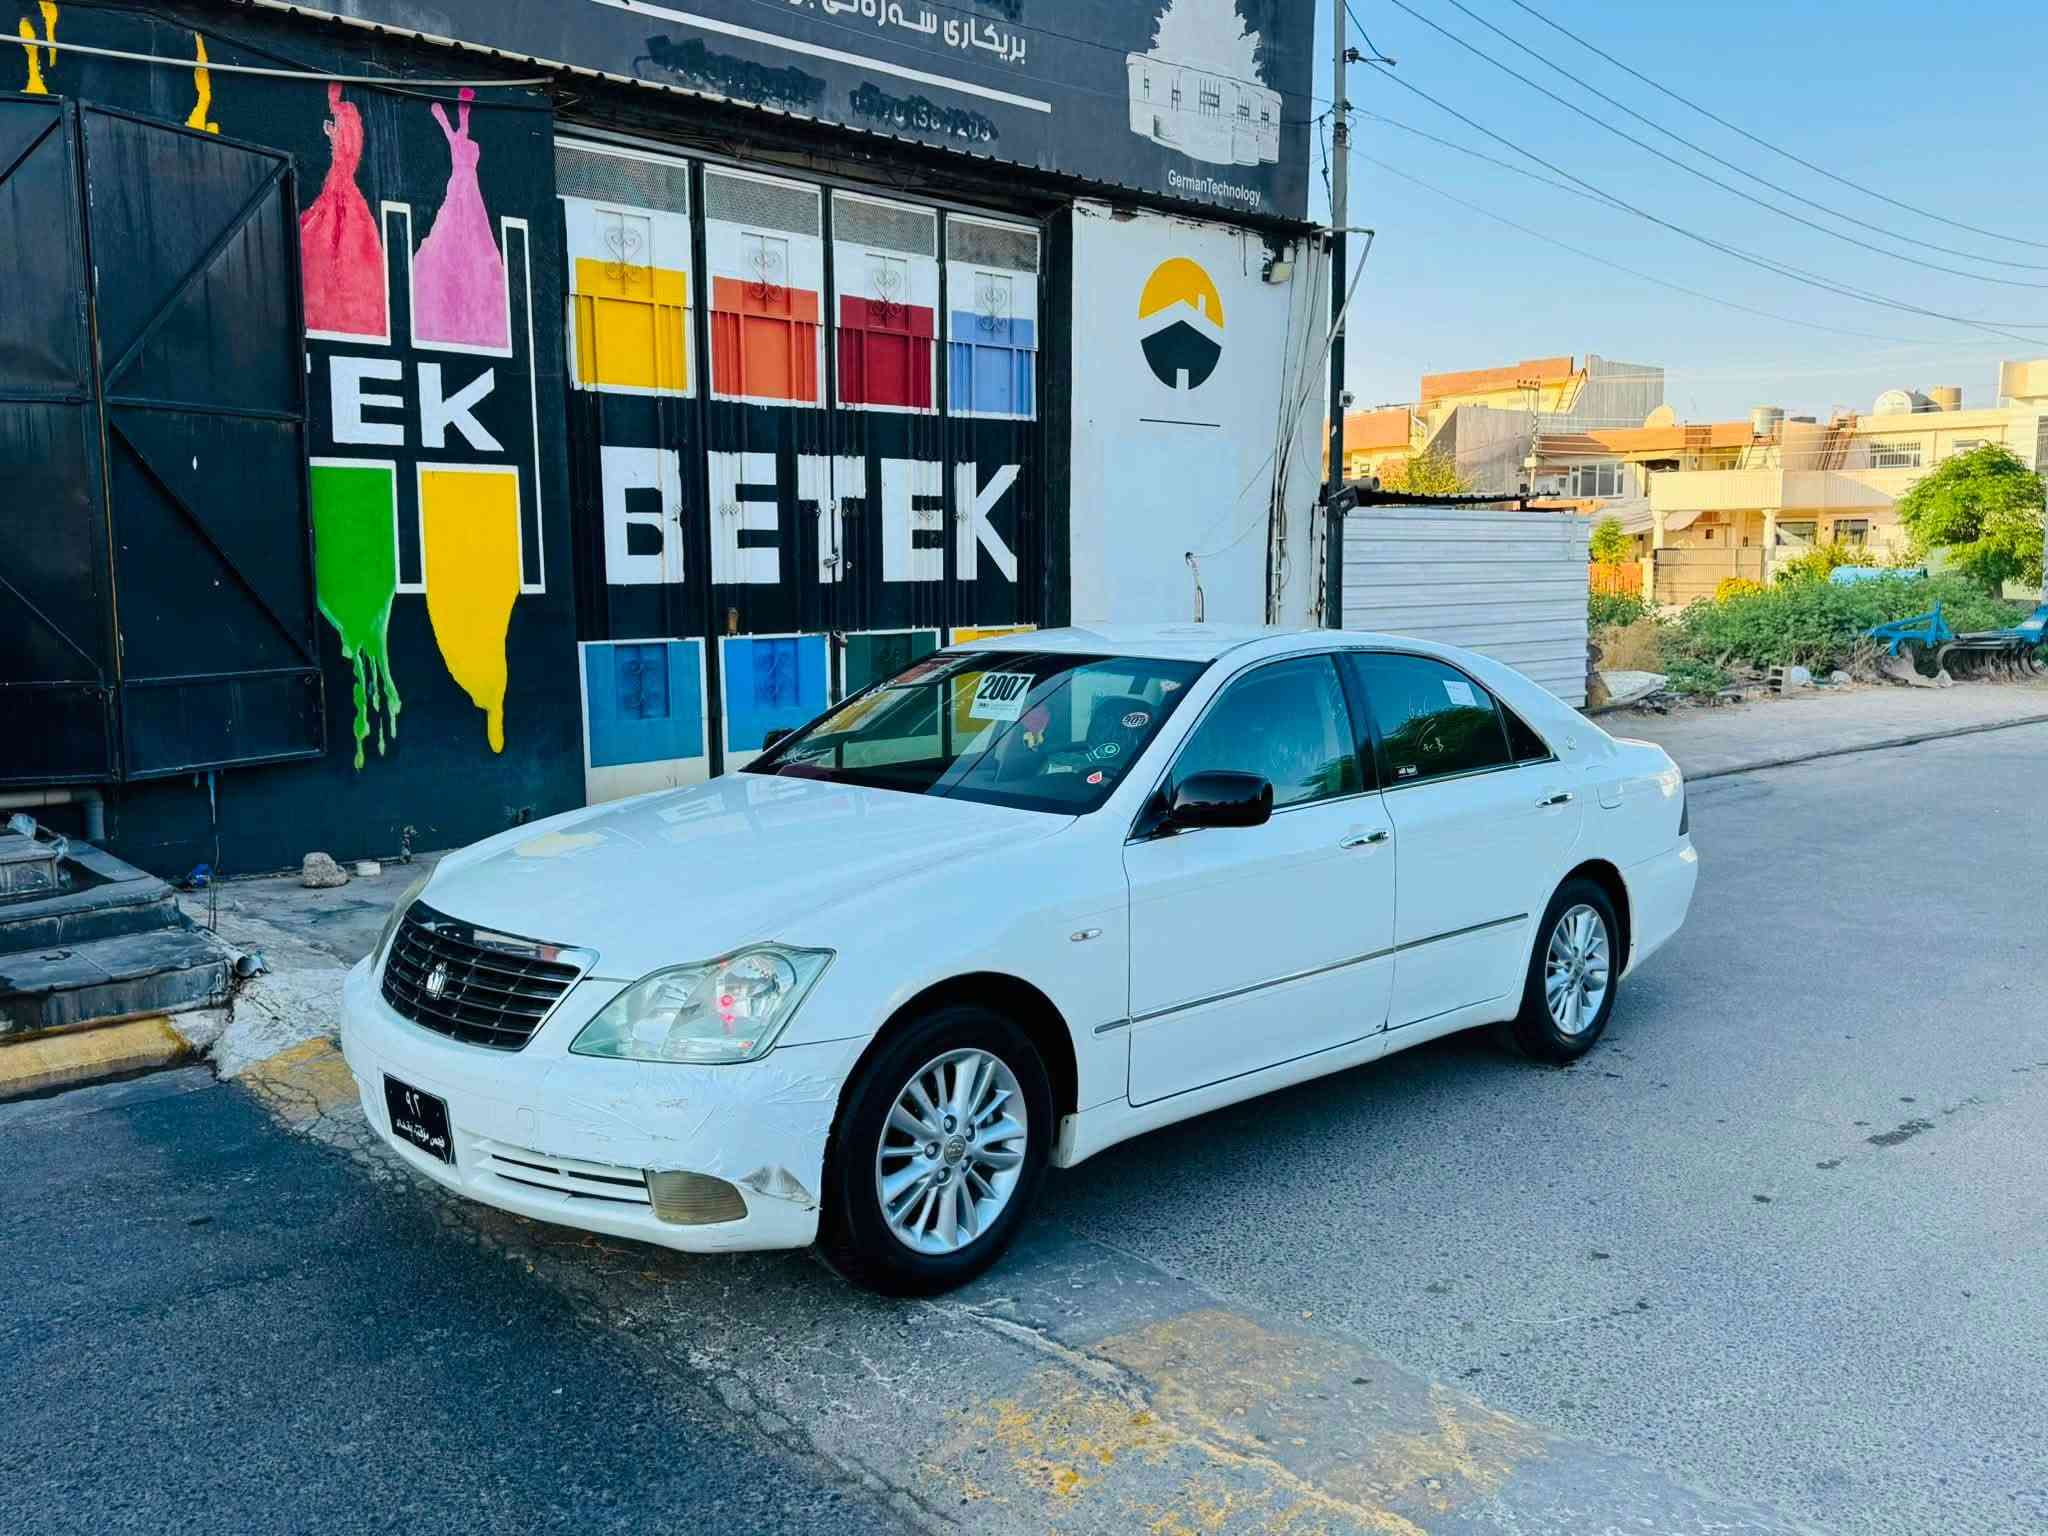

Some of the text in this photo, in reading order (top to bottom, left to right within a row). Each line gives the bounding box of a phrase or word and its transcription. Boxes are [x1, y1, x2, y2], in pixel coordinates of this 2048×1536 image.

[1168, 169, 1261, 207] GermanTechnology
[306, 352, 505, 452] EK
[600, 446, 1021, 585] BETEK
[976, 675, 1032, 701] 2007
